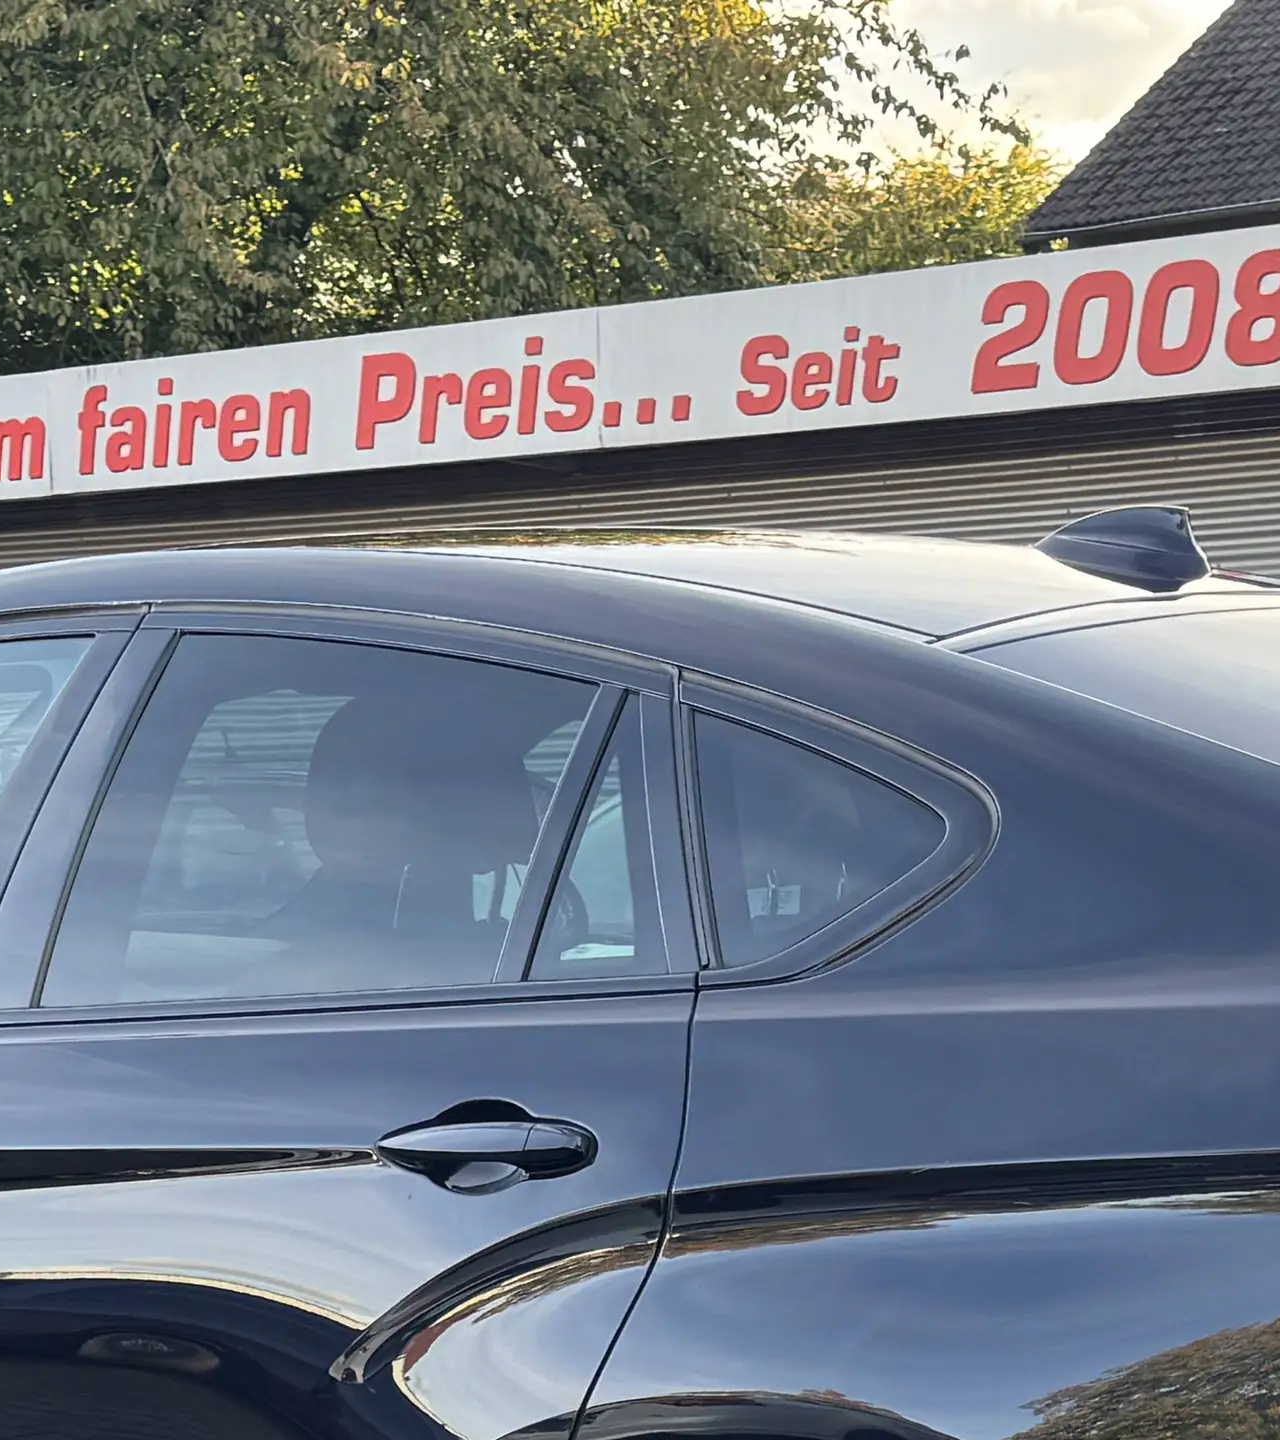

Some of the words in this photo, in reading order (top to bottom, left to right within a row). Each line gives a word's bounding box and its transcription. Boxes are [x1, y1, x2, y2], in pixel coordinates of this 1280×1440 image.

[78, 376, 311, 476] fairen
[356, 335, 692, 451] Preis...
[736, 325, 900, 417] Seit
